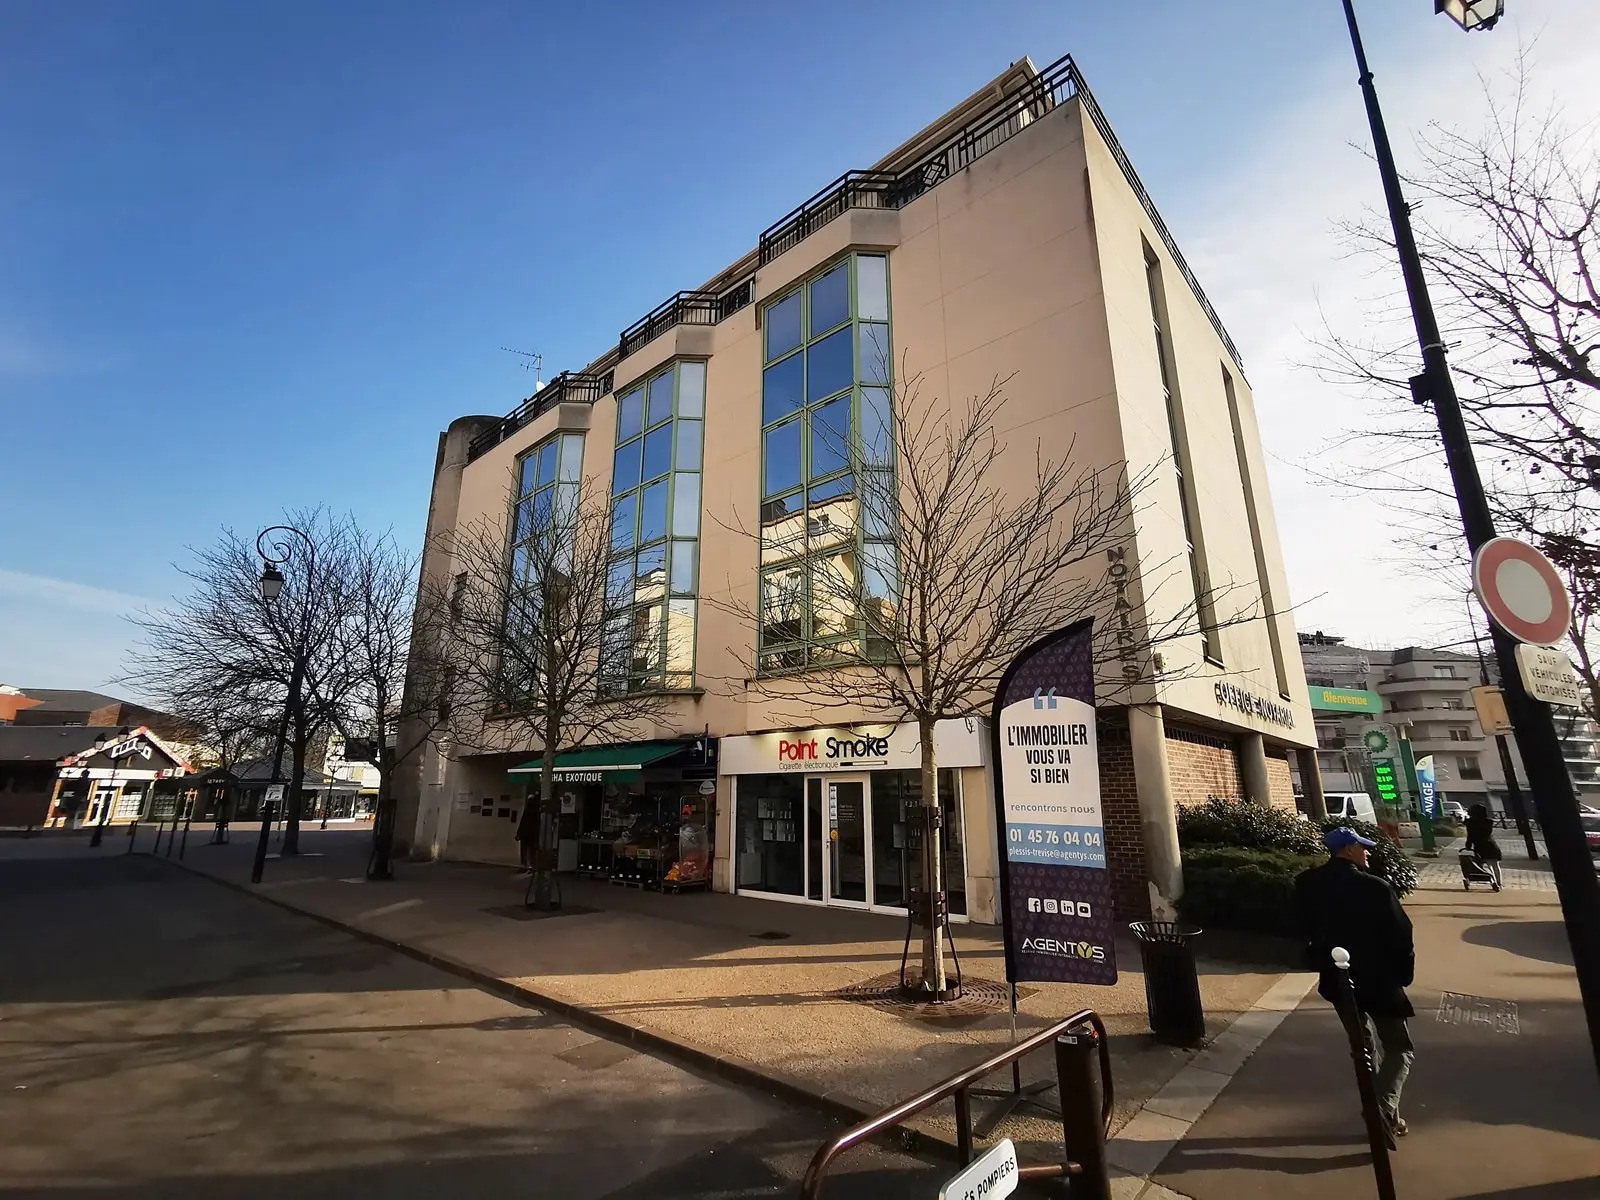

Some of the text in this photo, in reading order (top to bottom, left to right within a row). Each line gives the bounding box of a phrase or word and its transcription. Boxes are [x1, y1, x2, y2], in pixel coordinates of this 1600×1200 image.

[1537, 654, 1556, 666] SAUF
[1323, 690, 1368, 705] Bienvenue
[1007, 723, 1088, 746] L'IMMOBILIER
[779, 733, 889, 761] Point Smoke
[1026, 750, 1071, 764] VOUS VA
[778, 760, 839, 772] Cigarette électronique
[565, 772, 603, 783] EXOTIQUE
[1030, 769, 1070, 783] SI BIEN
[1422, 782, 1434, 819] AVAGE
[1010, 804, 1095, 814] rencontrons nous
[1009, 828, 1101, 847] 01 45 76 04 04
[1021, 937, 1105, 960] AGENTYS
[977, 1156, 1015, 1200] POMPIERS
